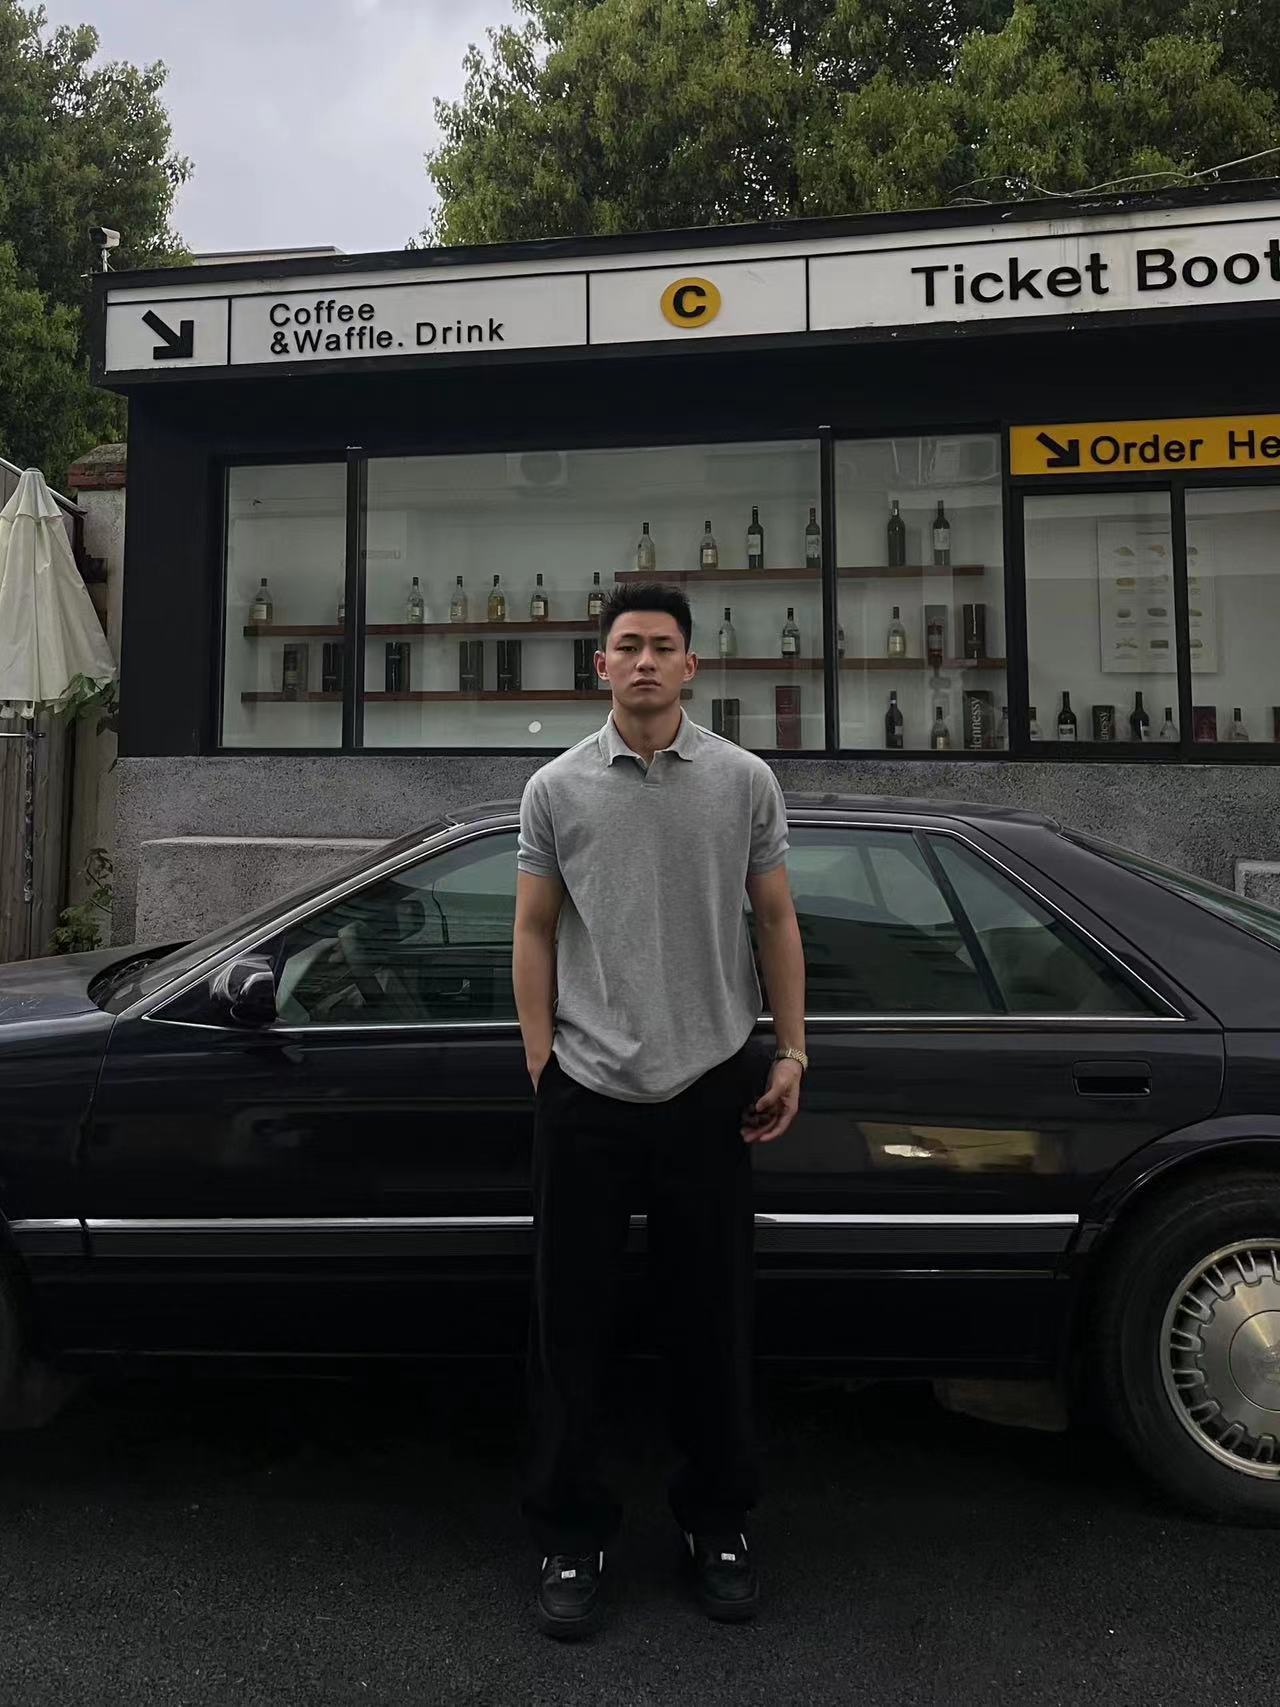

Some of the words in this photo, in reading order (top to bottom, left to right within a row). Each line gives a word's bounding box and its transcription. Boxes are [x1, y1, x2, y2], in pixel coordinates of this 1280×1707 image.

[911, 253, 1109, 306] Ticket
[269, 299, 375, 327] Coffee
[673, 285, 706, 318] C
[416, 318, 505, 346] Drink
[1090, 434, 1204, 465] Order
[1228, 429, 1280, 460] He
